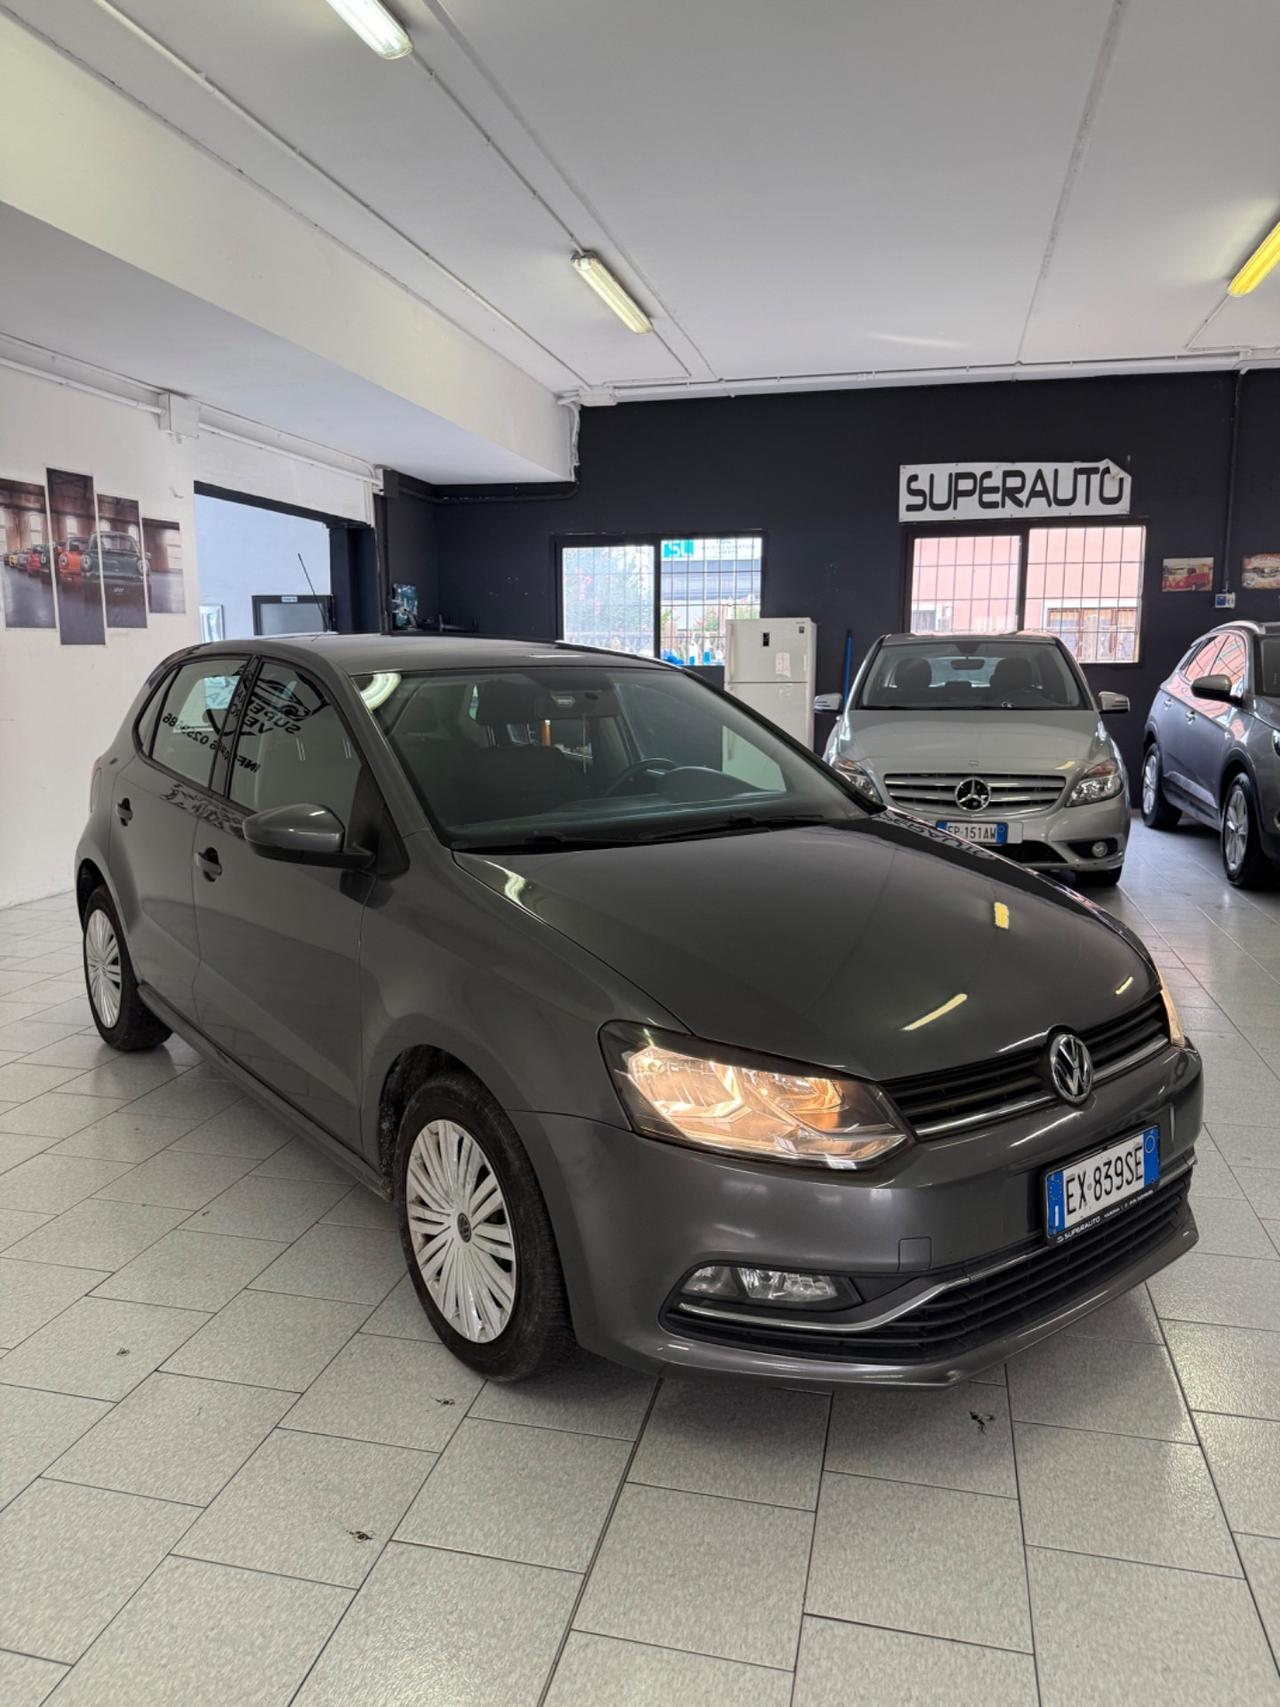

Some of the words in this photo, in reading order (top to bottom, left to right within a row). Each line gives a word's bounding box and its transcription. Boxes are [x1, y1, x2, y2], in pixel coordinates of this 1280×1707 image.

[905, 466, 1124, 512] SUPERAUTO
[1066, 1168, 1087, 1216] EX
[1093, 1146, 1143, 1202] 839SE
